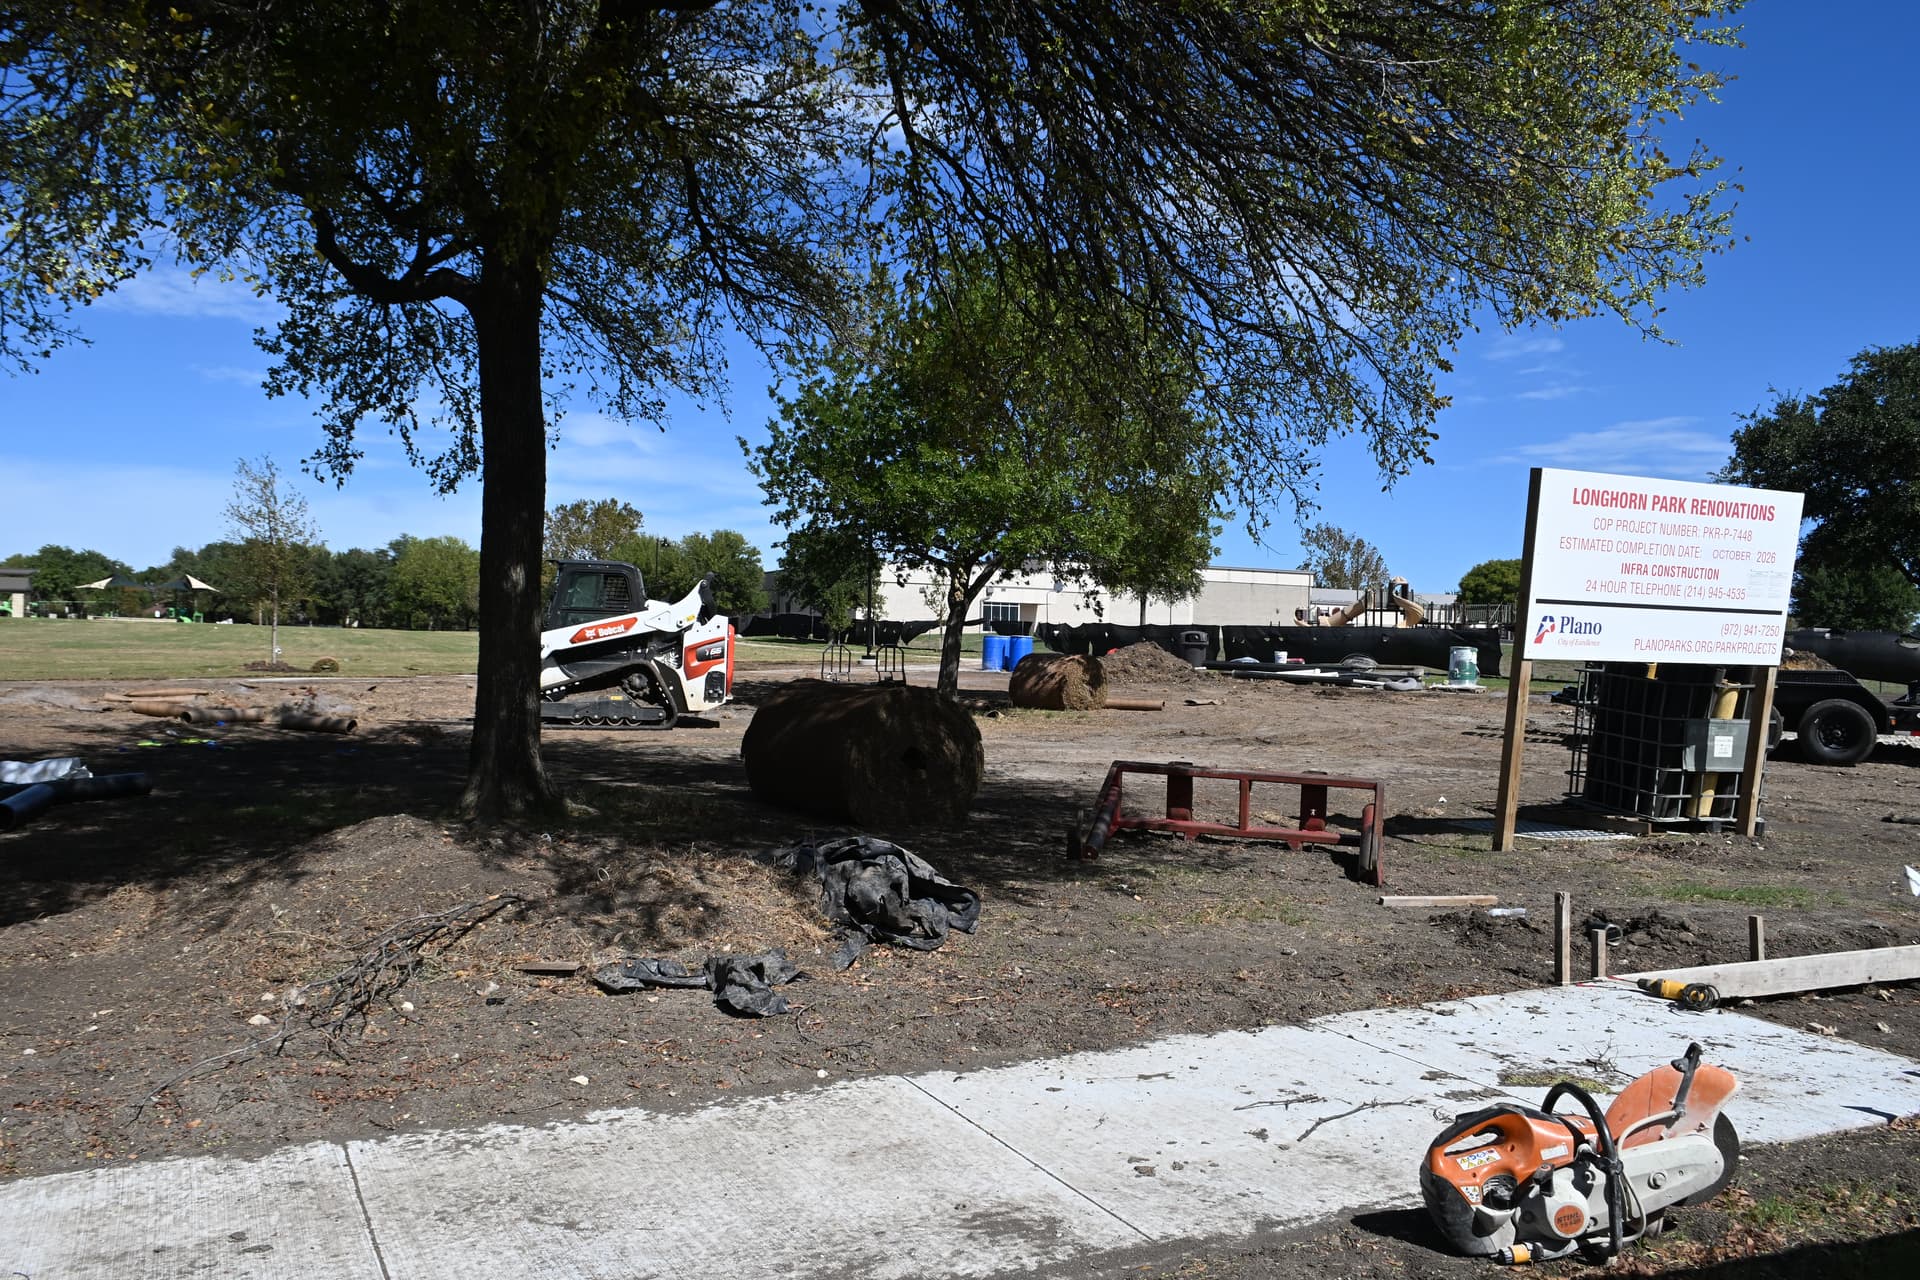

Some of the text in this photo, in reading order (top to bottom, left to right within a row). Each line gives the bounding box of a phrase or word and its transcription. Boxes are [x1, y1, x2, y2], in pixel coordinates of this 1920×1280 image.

[1572, 488, 1776, 522] LONGHORN PARK RENOVATIONS
[1593, 517, 1614, 531] COP
[1615, 519, 1658, 535] PROJECT
[1703, 526, 1753, 542] PKR-P-7448
[1559, 536, 1777, 564] ESTIMATED COMPLETION DATE: OCTOBER 2026
[1620, 562, 1720, 581] INFRA CONSTRUCTION
[1585, 579, 1746, 600] 24 HOUR TELEPHONE (214) 945-4535
[598, 624, 625, 637] Bobcat
[1559, 615, 1603, 635] Plano
[1720, 623, 1780, 638] (972) 941-7250
[1634, 638, 1778, 655] PLANOPARKS.ORG/PARKPROJECTS
